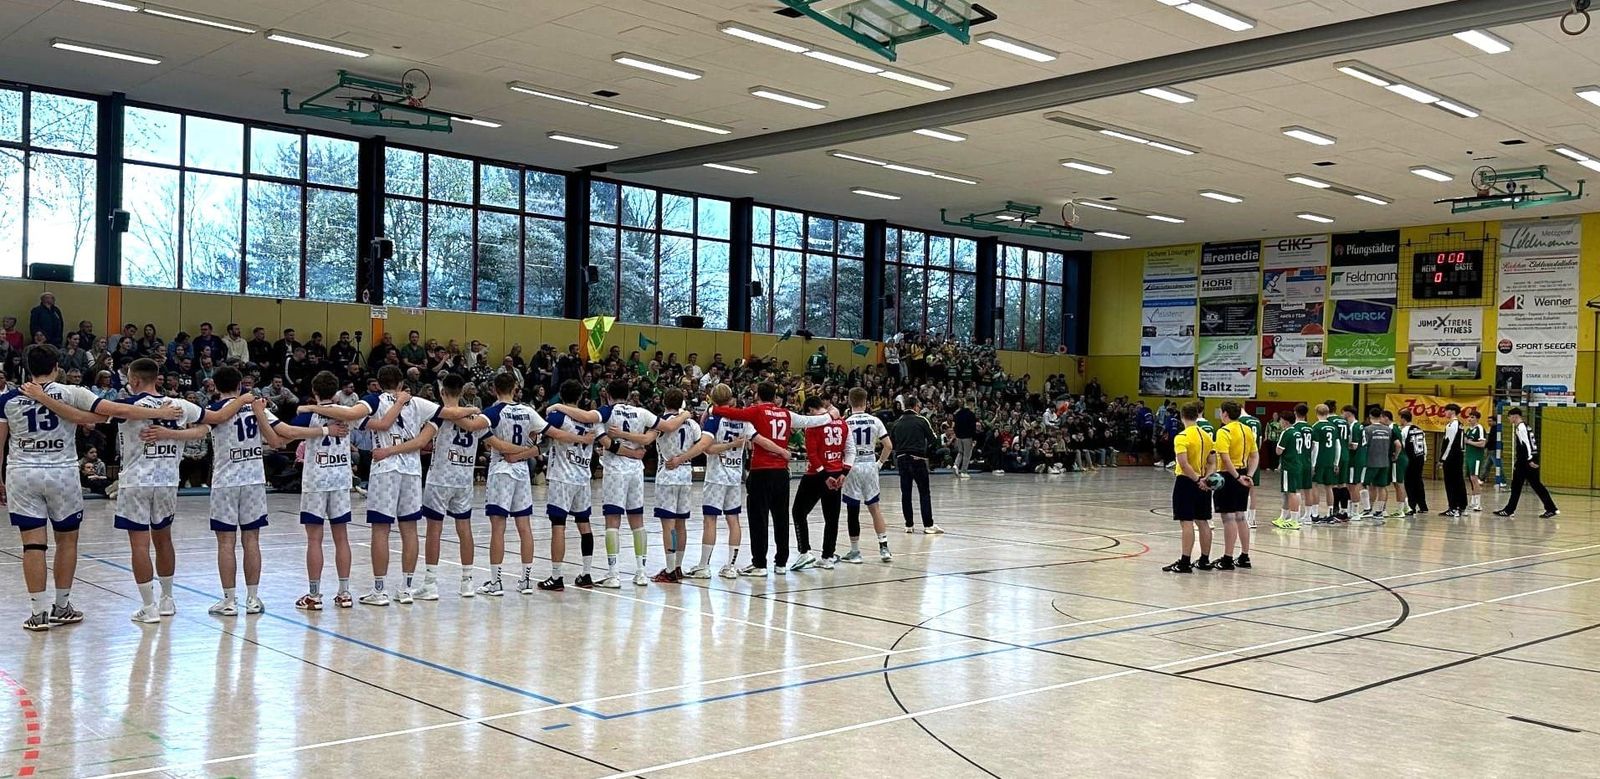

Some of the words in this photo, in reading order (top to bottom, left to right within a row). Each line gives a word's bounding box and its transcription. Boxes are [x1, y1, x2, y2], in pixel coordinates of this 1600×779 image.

[1346, 242, 1396, 257] Pfungstädter
[1213, 249, 1259, 263] remedia
[1346, 269, 1398, 283] Feldmann
[1534, 297, 1573, 307] Wenner
[1443, 326, 1473, 335] FITNESS
[1432, 346, 1461, 357] ASEO
[1544, 342, 1577, 350] SEEGER
[1264, 366, 1305, 377] Smolek
[1200, 381, 1232, 392] Baltz
[22, 405, 59, 433] 13
[233, 414, 258, 442] 18
[769, 418, 787, 441] 12
[511, 424, 522, 446] 8
[823, 426, 842, 447] 33
[852, 426, 871, 446] 11
[1325, 432, 1334, 448] 3
[36, 438, 64, 449] DIG
[157, 444, 177, 455] DIG
[242, 447, 262, 458] DIG
[330, 454, 348, 464] DIG
[726, 458, 741, 466] DIG
